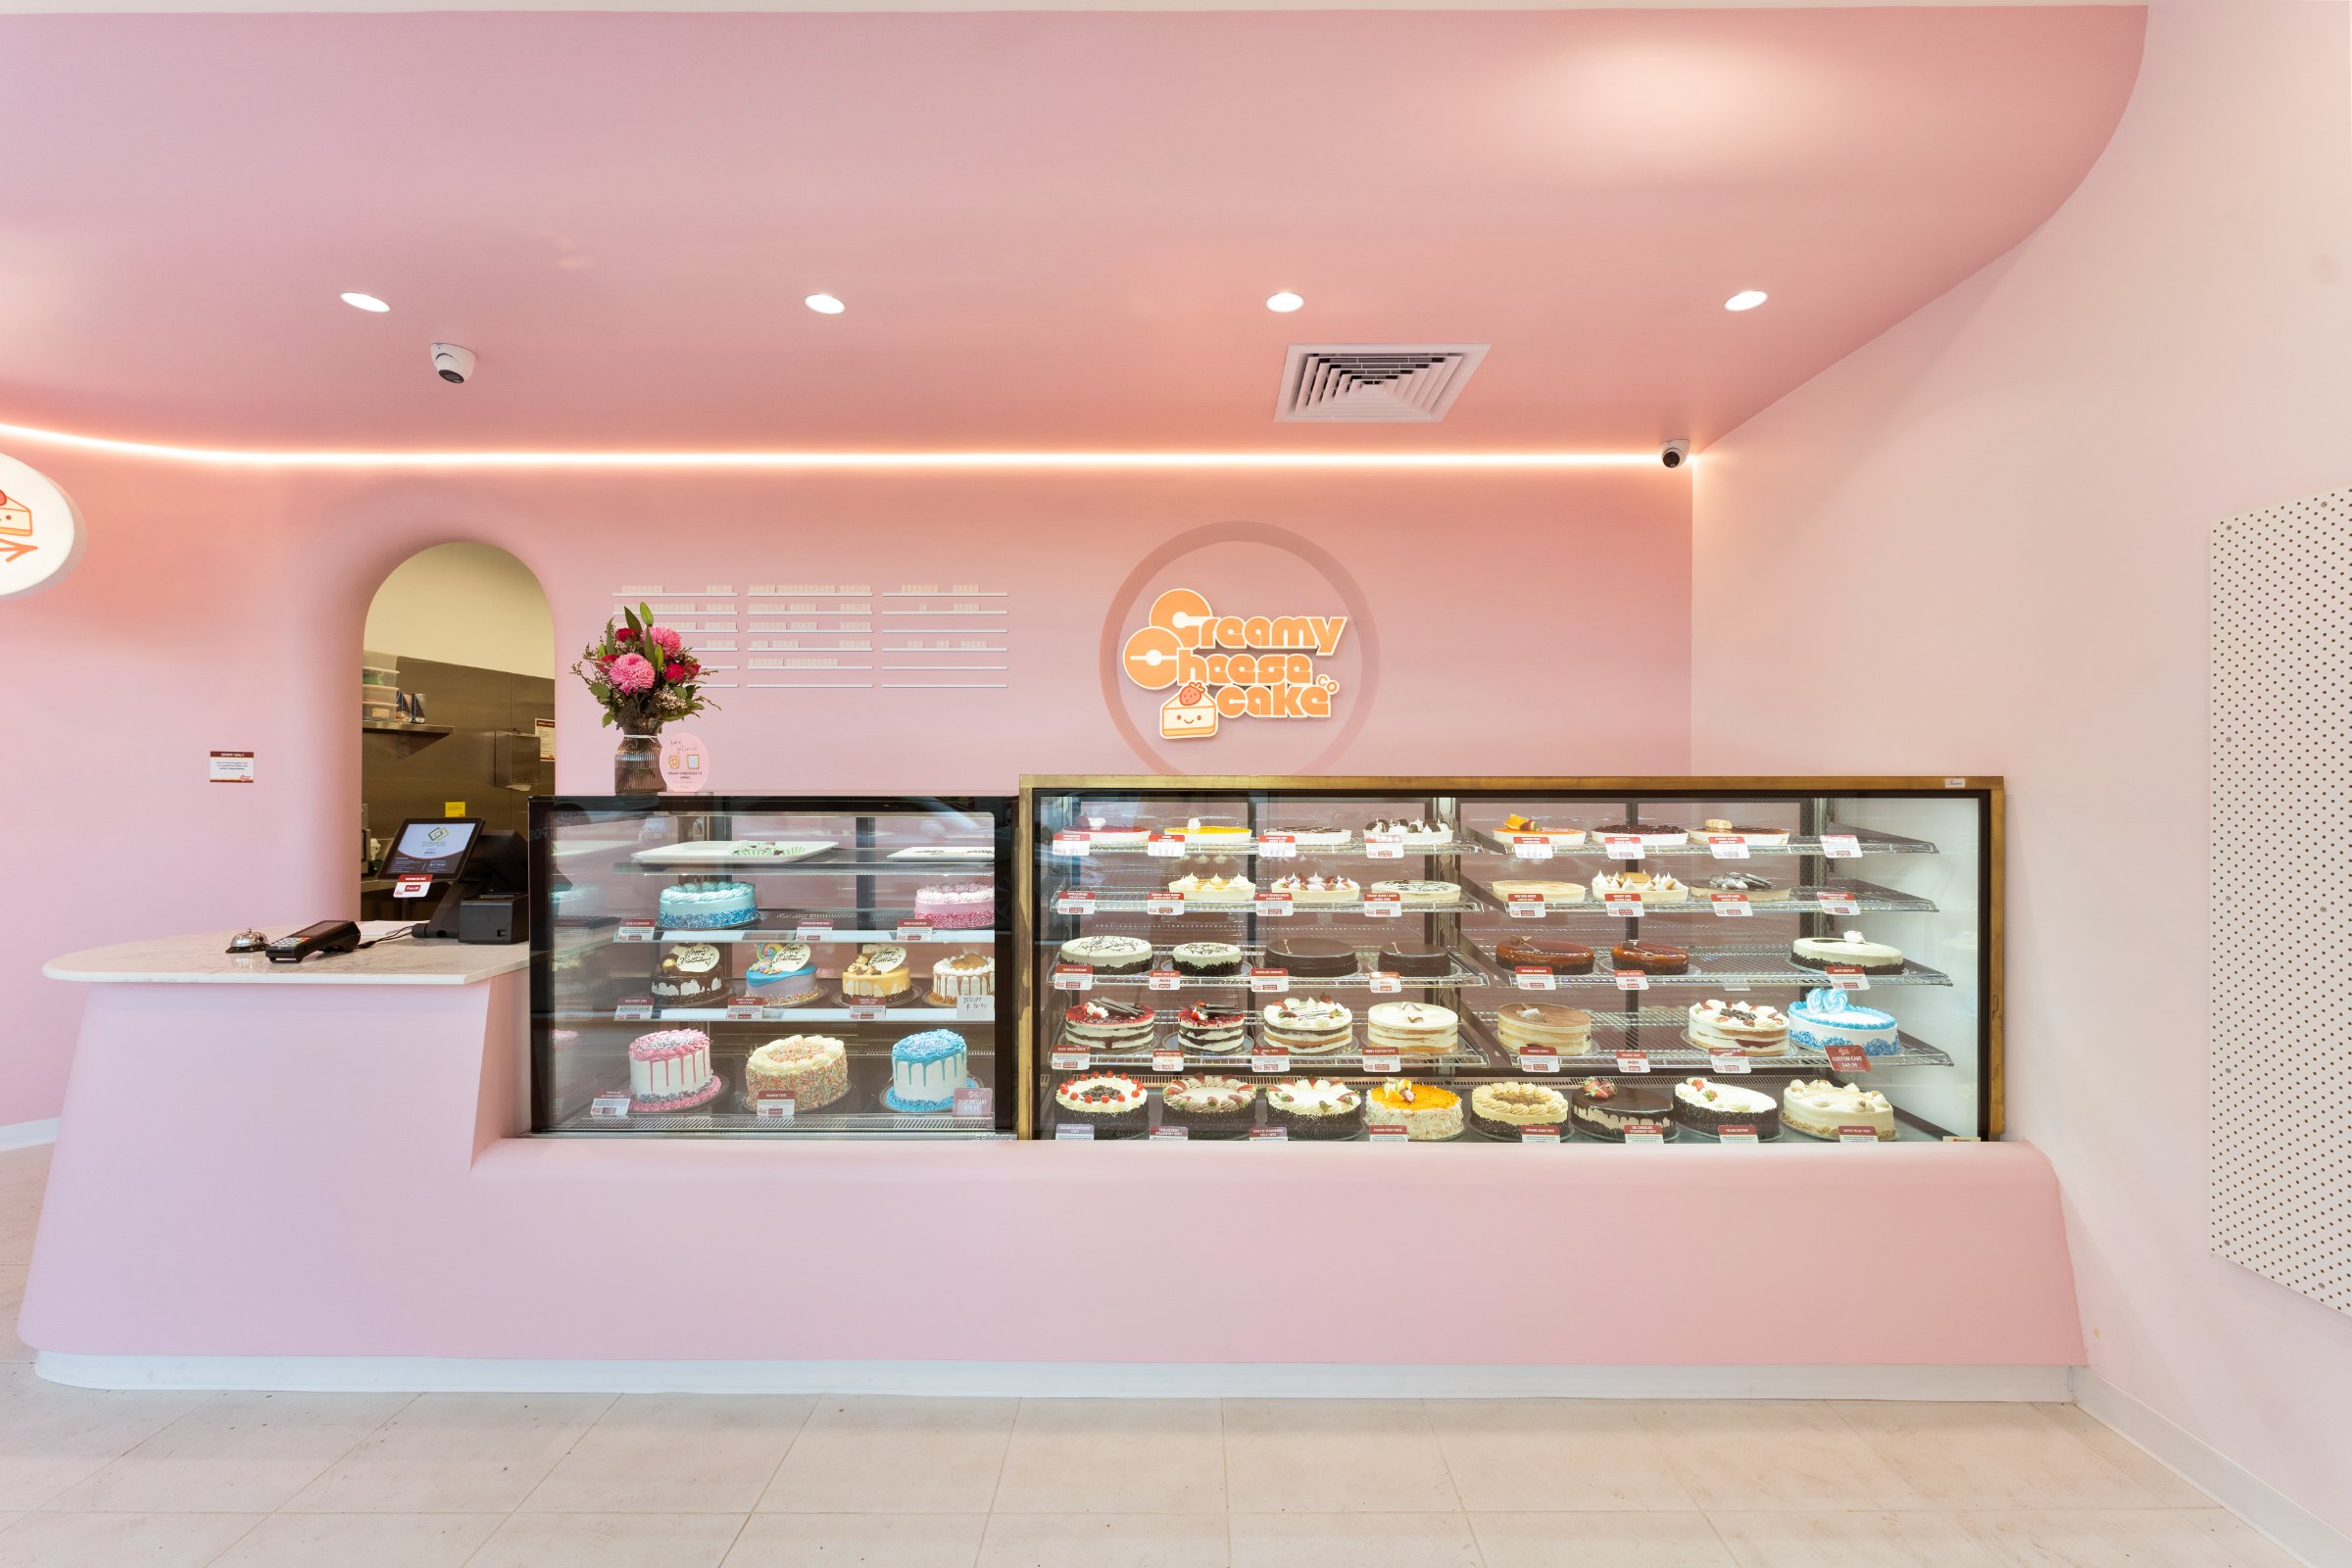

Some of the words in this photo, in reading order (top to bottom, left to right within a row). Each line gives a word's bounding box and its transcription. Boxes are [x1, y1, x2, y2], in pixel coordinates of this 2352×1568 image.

[1150, 589, 1348, 656] Creamy
[1123, 626, 1313, 690] Cheese
[1216, 683, 1332, 718] cake
